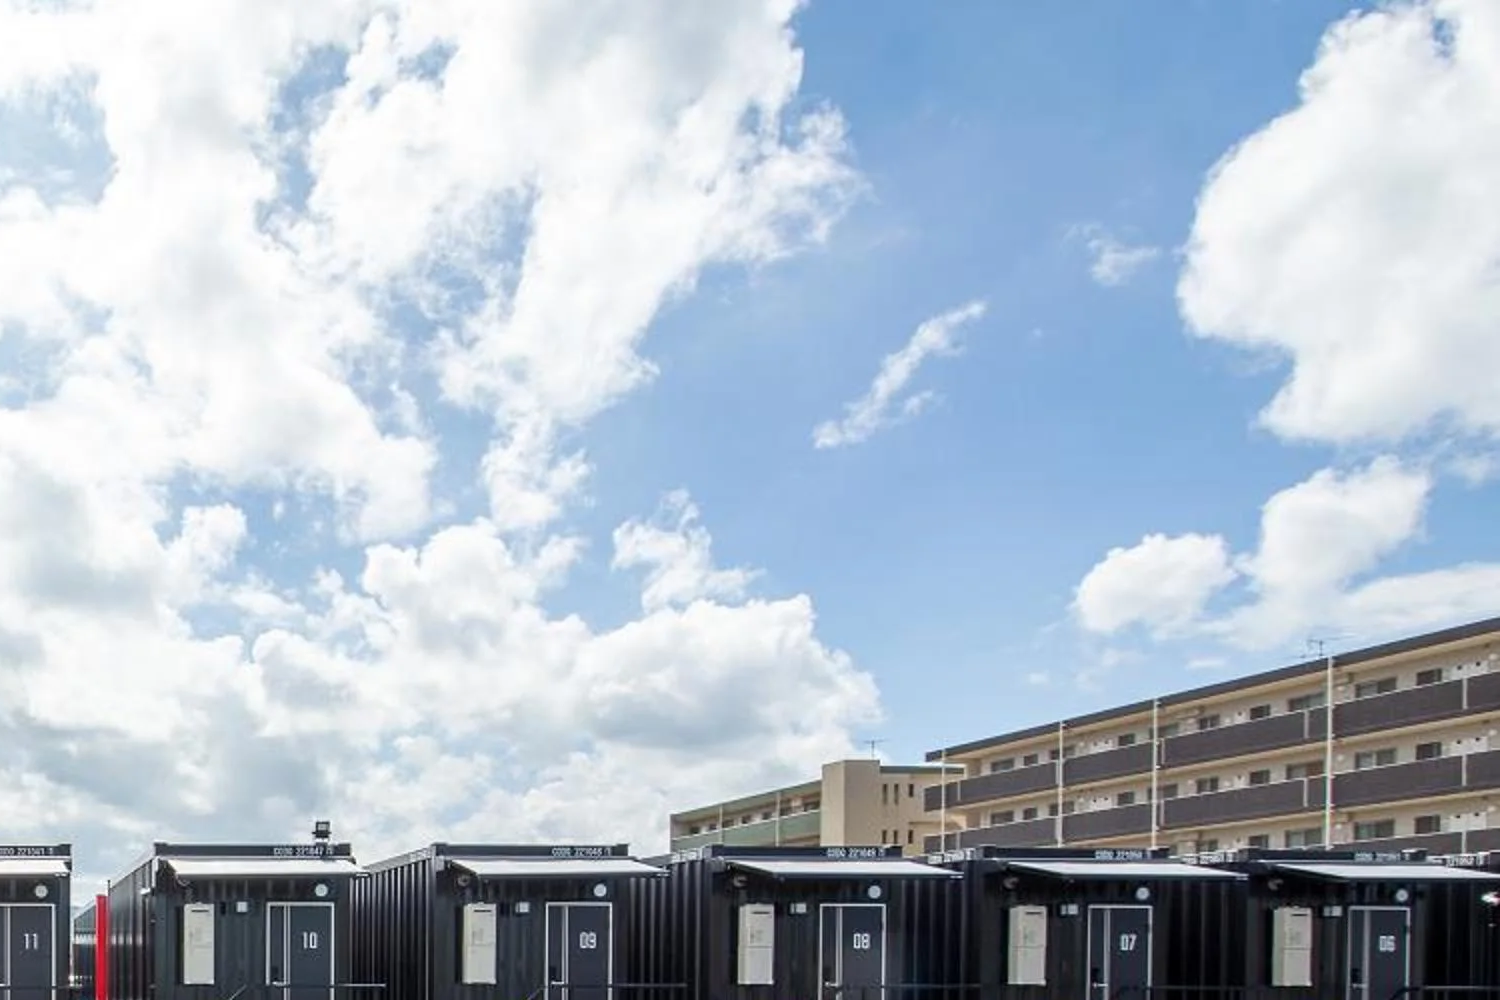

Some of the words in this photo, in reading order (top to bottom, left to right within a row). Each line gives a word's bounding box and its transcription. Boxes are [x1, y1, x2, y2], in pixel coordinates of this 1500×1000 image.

[25, 933, 38, 949] 11
[303, 932, 316, 948] 10
[580, 932, 596, 948] 09
[854, 933, 870, 949] 08
[1121, 935, 1137, 950] 07
